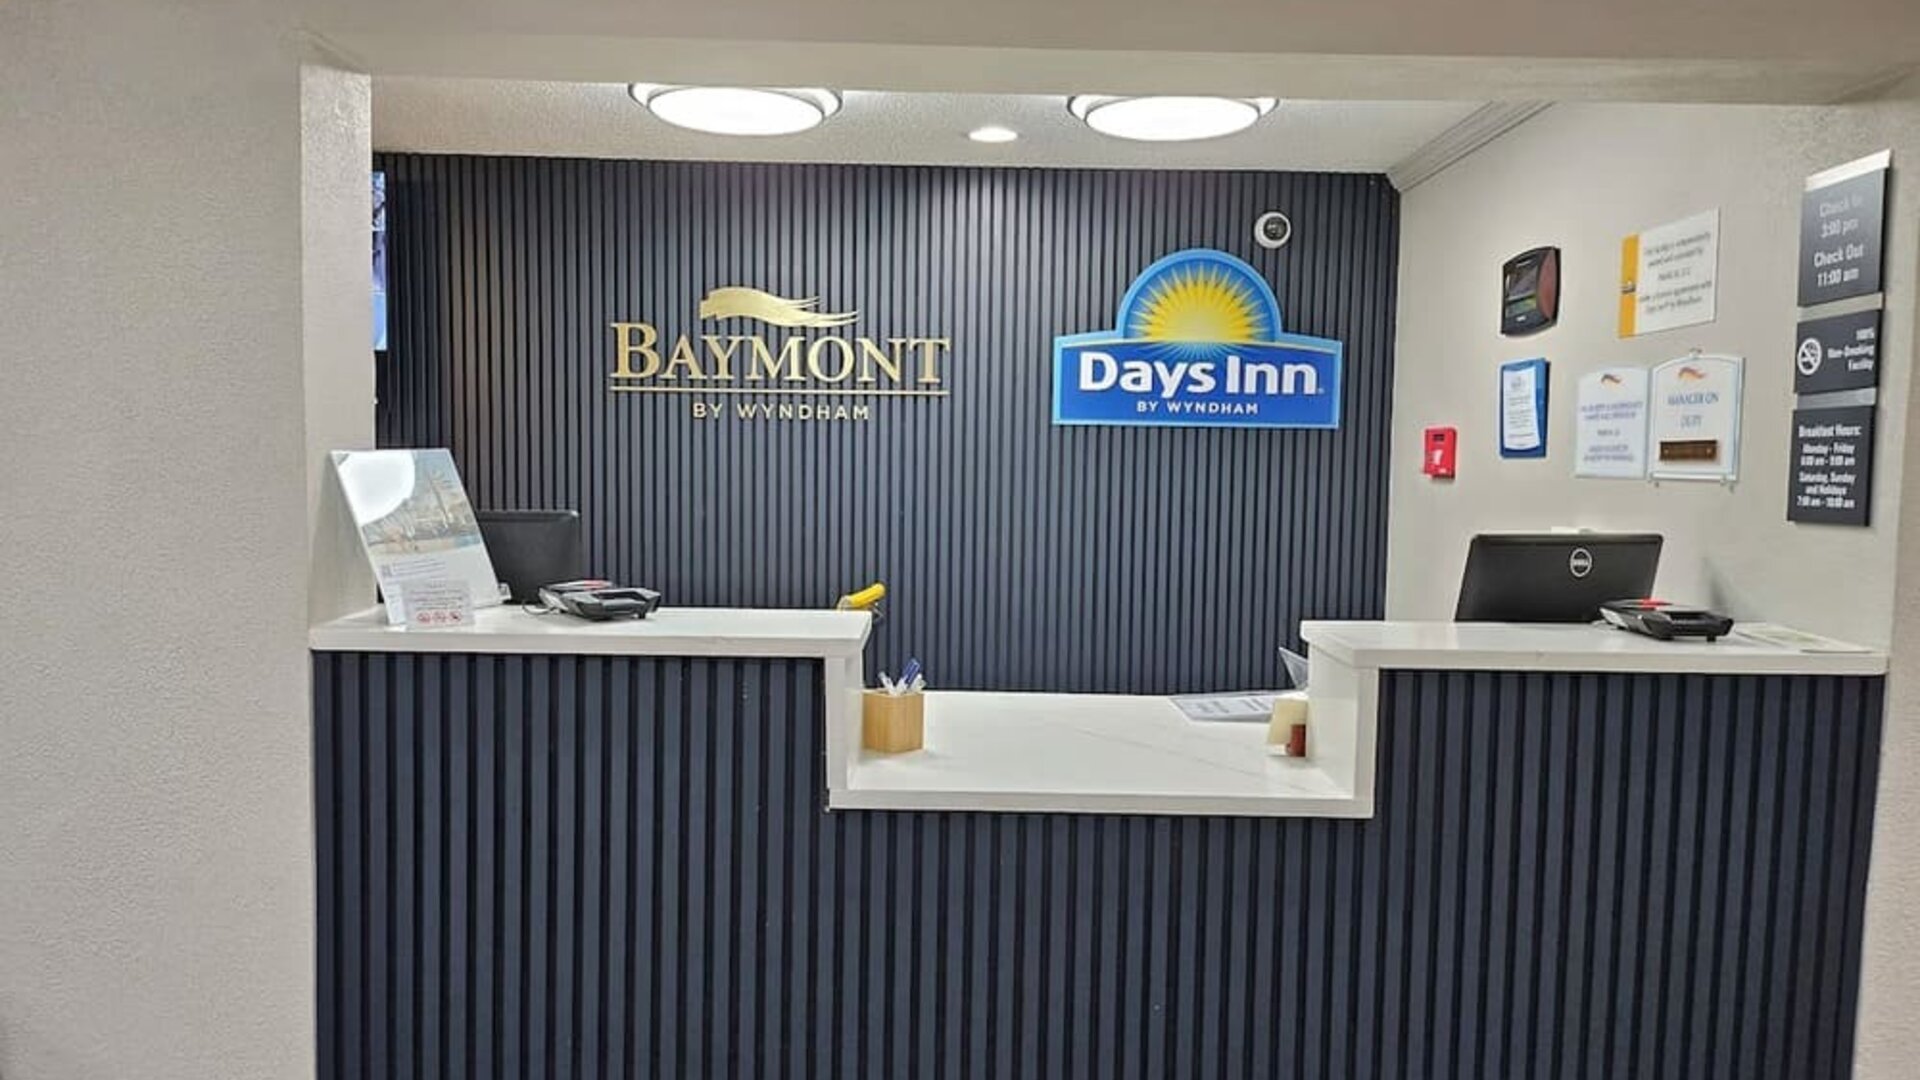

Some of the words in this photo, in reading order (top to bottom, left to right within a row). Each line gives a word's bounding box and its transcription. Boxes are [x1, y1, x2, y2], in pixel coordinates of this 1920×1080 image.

[1819, 197, 1849, 217] Check
[1821, 219, 1841, 238] 3:00
[1842, 218, 1859, 236] pm
[1814, 247, 1844, 267] Check
[1846, 243, 1864, 260] Out
[1817, 269, 1842, 287] 11:00
[1843, 268, 1859, 282] am
[610, 322, 951, 384] BAYMONT
[1079, 351, 1216, 399] Days
[1226, 355, 1318, 395] Inn
[692, 403, 723, 419] BY
[737, 404, 870, 420] WYNDHAM
[1136, 401, 1159, 414] BY
[1168, 402, 1259, 416] WYNDHAM
[1799, 425, 1834, 438] Breakfast
